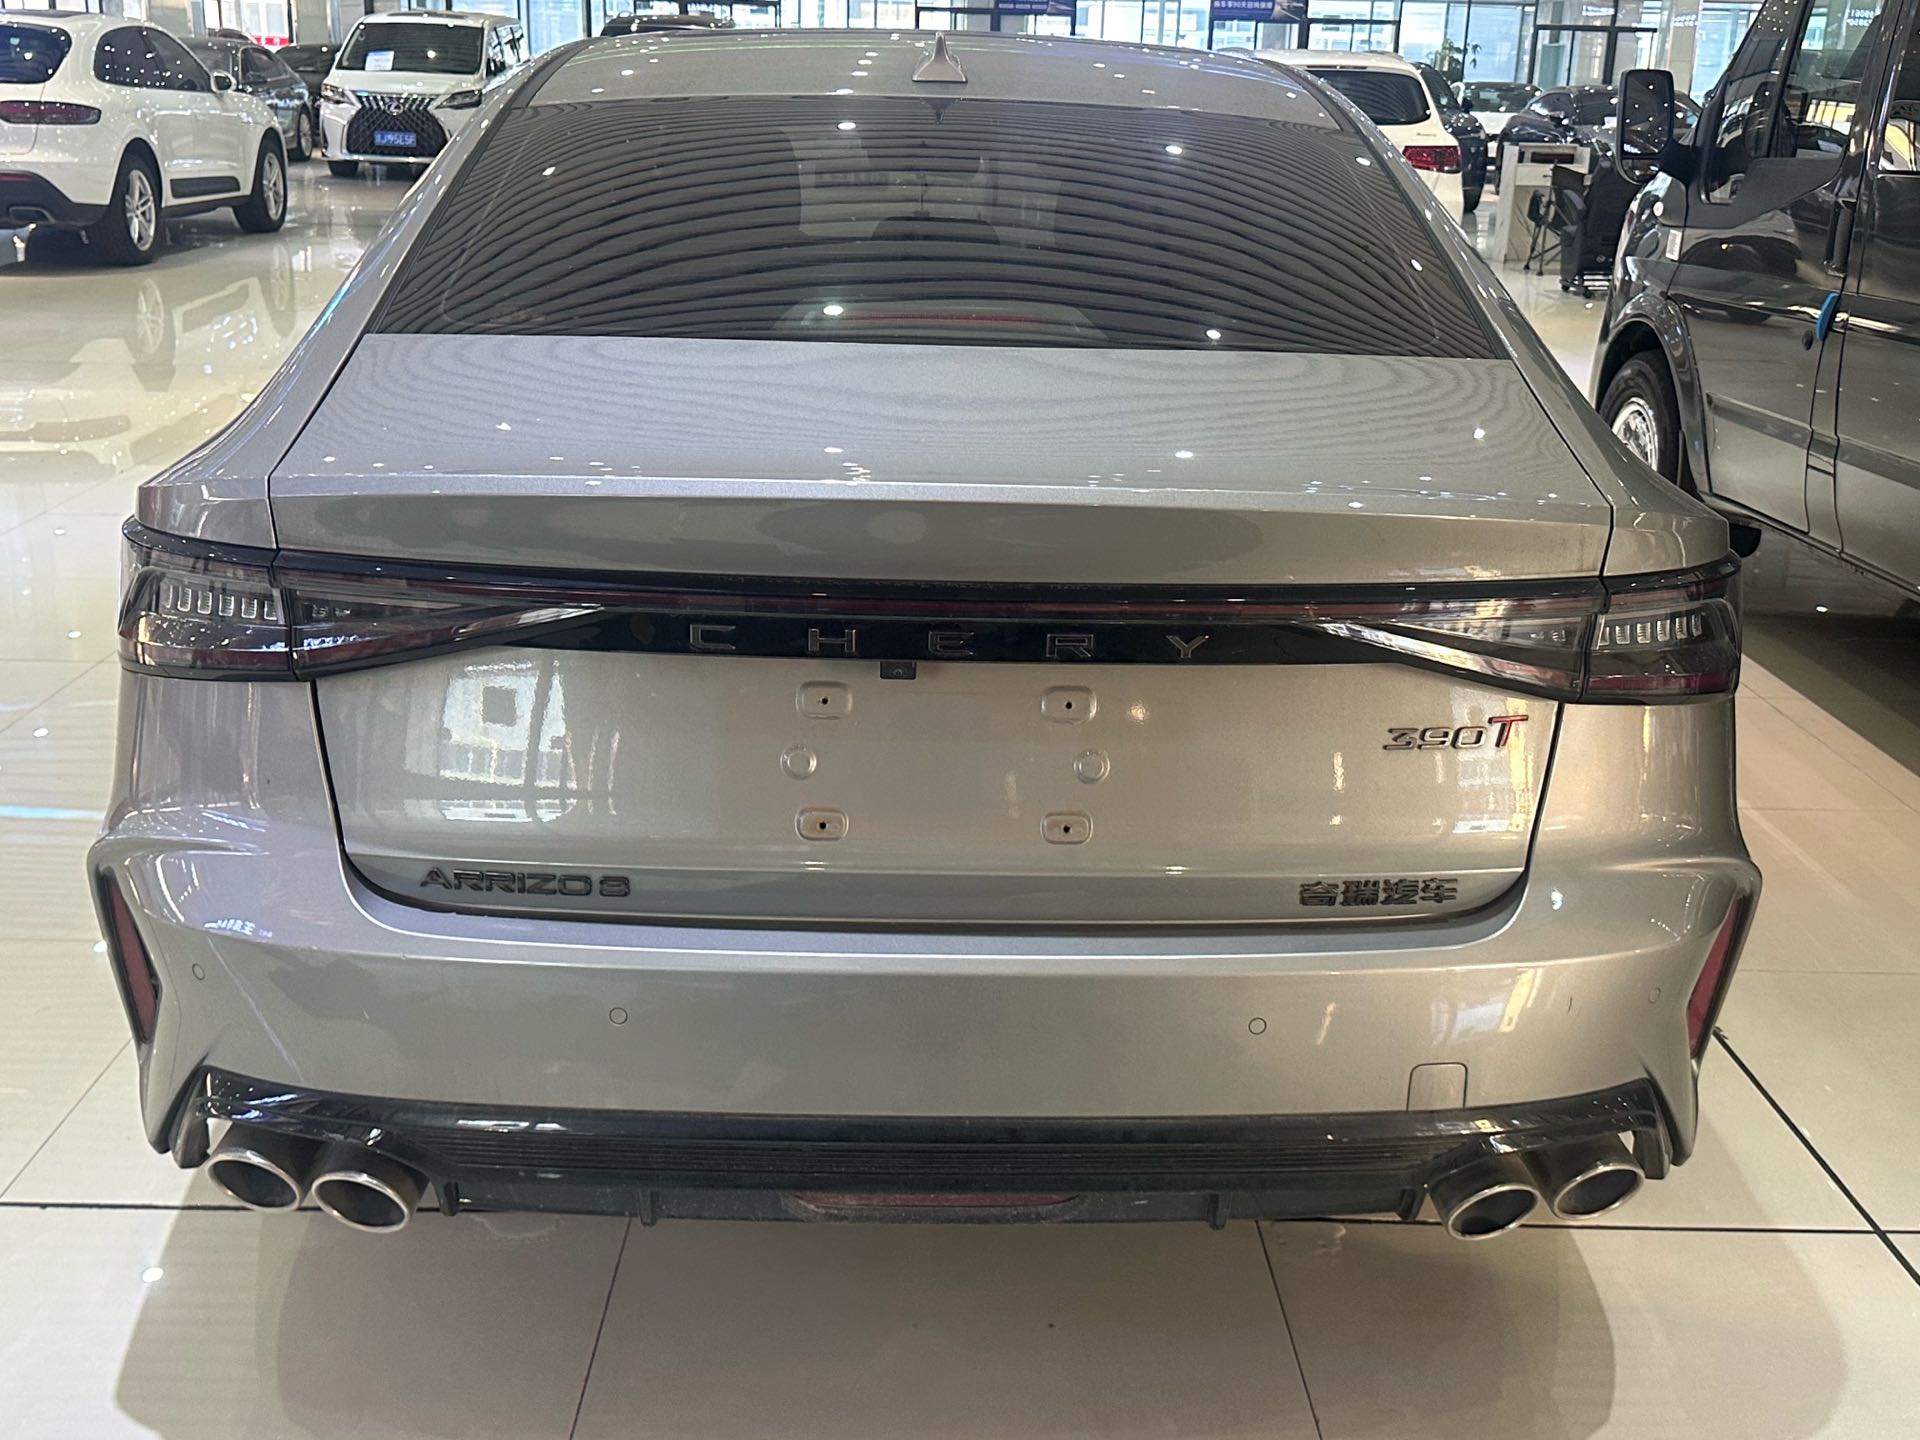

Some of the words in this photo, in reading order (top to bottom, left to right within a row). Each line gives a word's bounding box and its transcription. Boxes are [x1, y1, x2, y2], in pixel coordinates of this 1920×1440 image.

[688, 623, 1210, 660] CHERY
[1382, 714, 1529, 751] 390T
[420, 866, 593, 896] ARRIZO
[599, 875, 631, 897] 8
[1299, 877, 1458, 907] 奇瑞汽车
